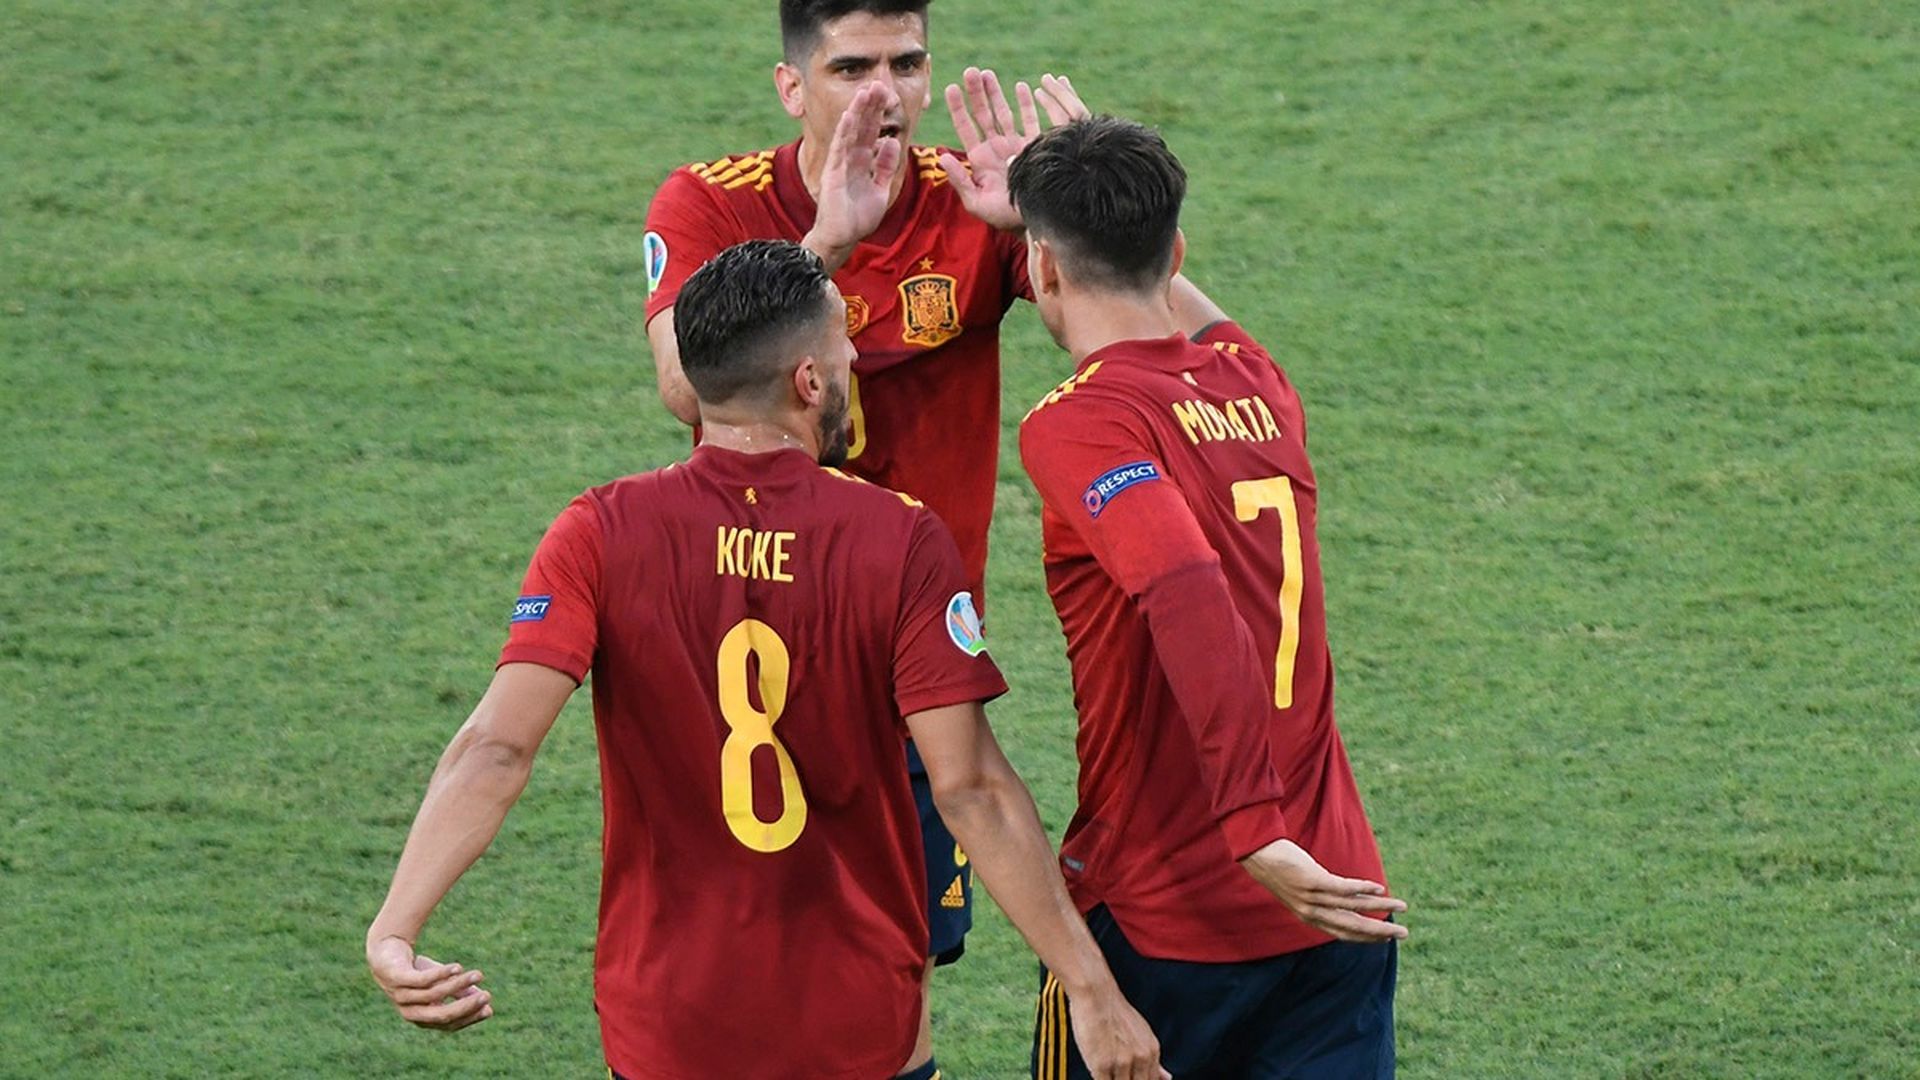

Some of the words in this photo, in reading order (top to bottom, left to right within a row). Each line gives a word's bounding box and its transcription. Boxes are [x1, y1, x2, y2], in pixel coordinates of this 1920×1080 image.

[1097, 465, 1155, 496] RESPECT
[717, 526, 796, 582] KOKE
[513, 602, 549, 615] SPECT
[1232, 475, 1302, 709] 7
[717, 618, 807, 853] 8
